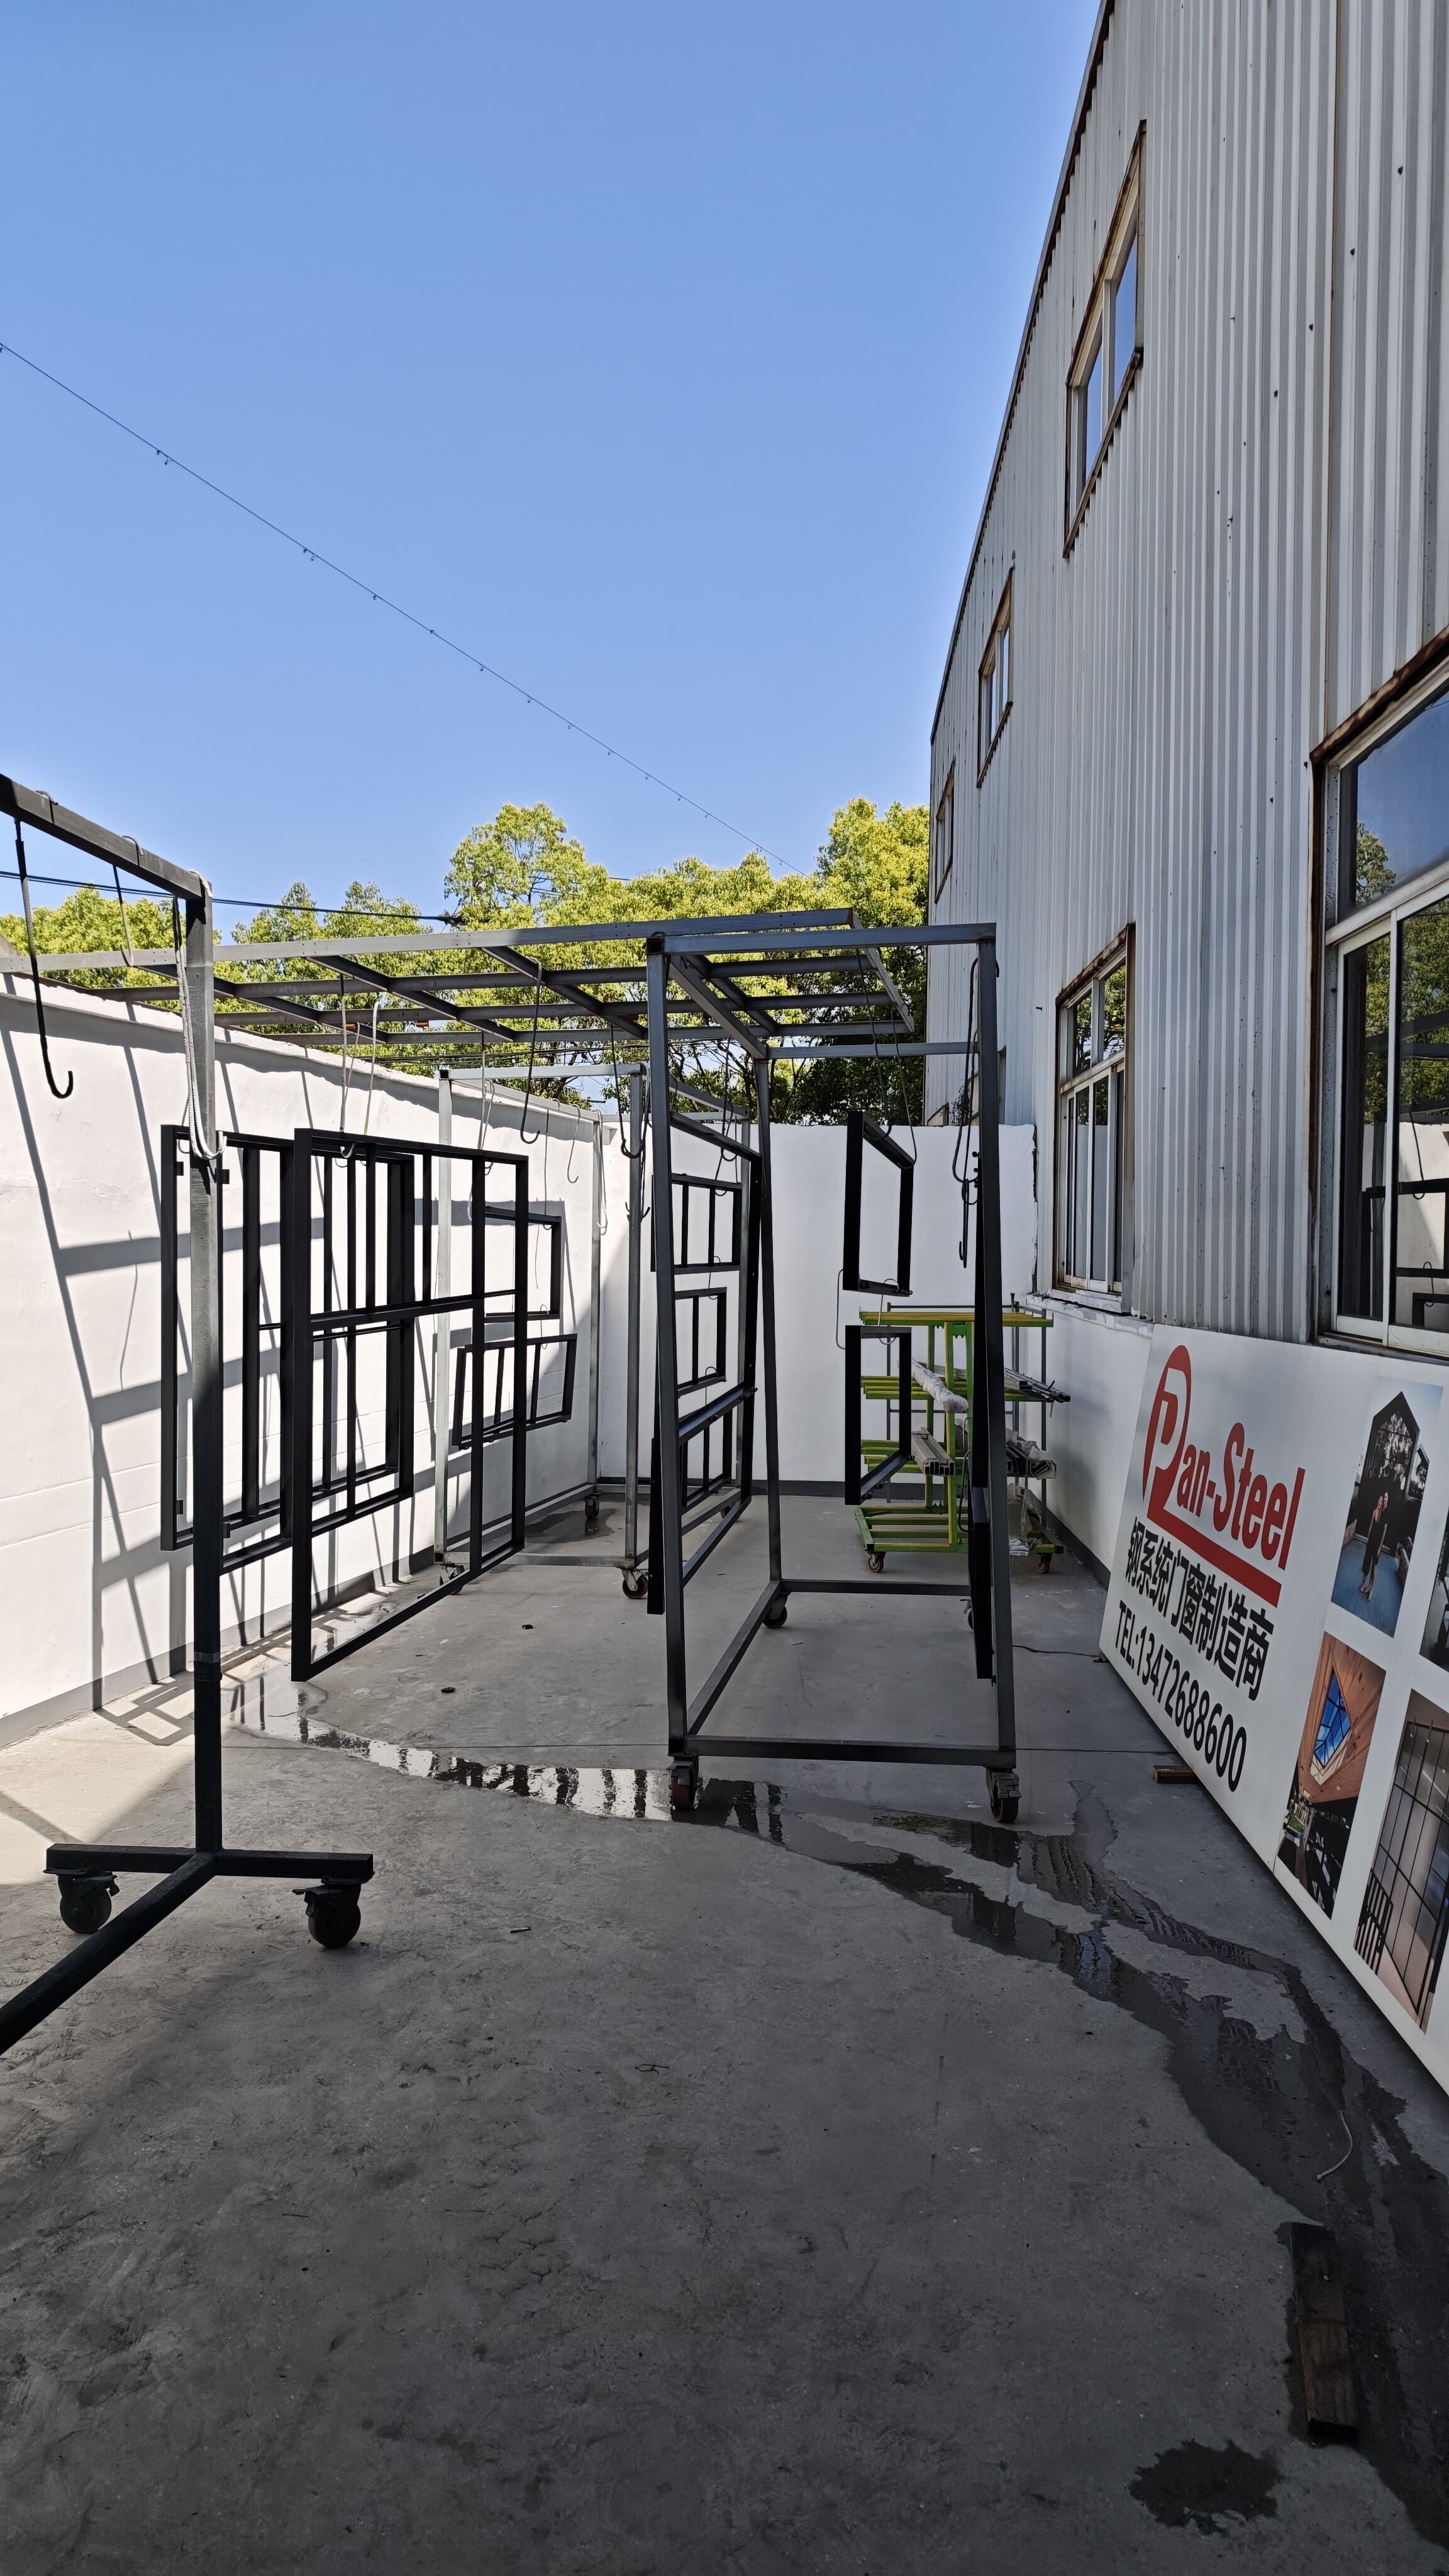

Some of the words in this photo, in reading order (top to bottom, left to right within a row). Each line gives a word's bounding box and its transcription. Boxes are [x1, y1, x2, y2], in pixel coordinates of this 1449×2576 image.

[1142, 1345, 1306, 1571] Pan-Steel
[1115, 1599, 1247, 1792] TEL:13472688600
[1125, 1516, 1275, 1701] 钢系统门窗制造商
